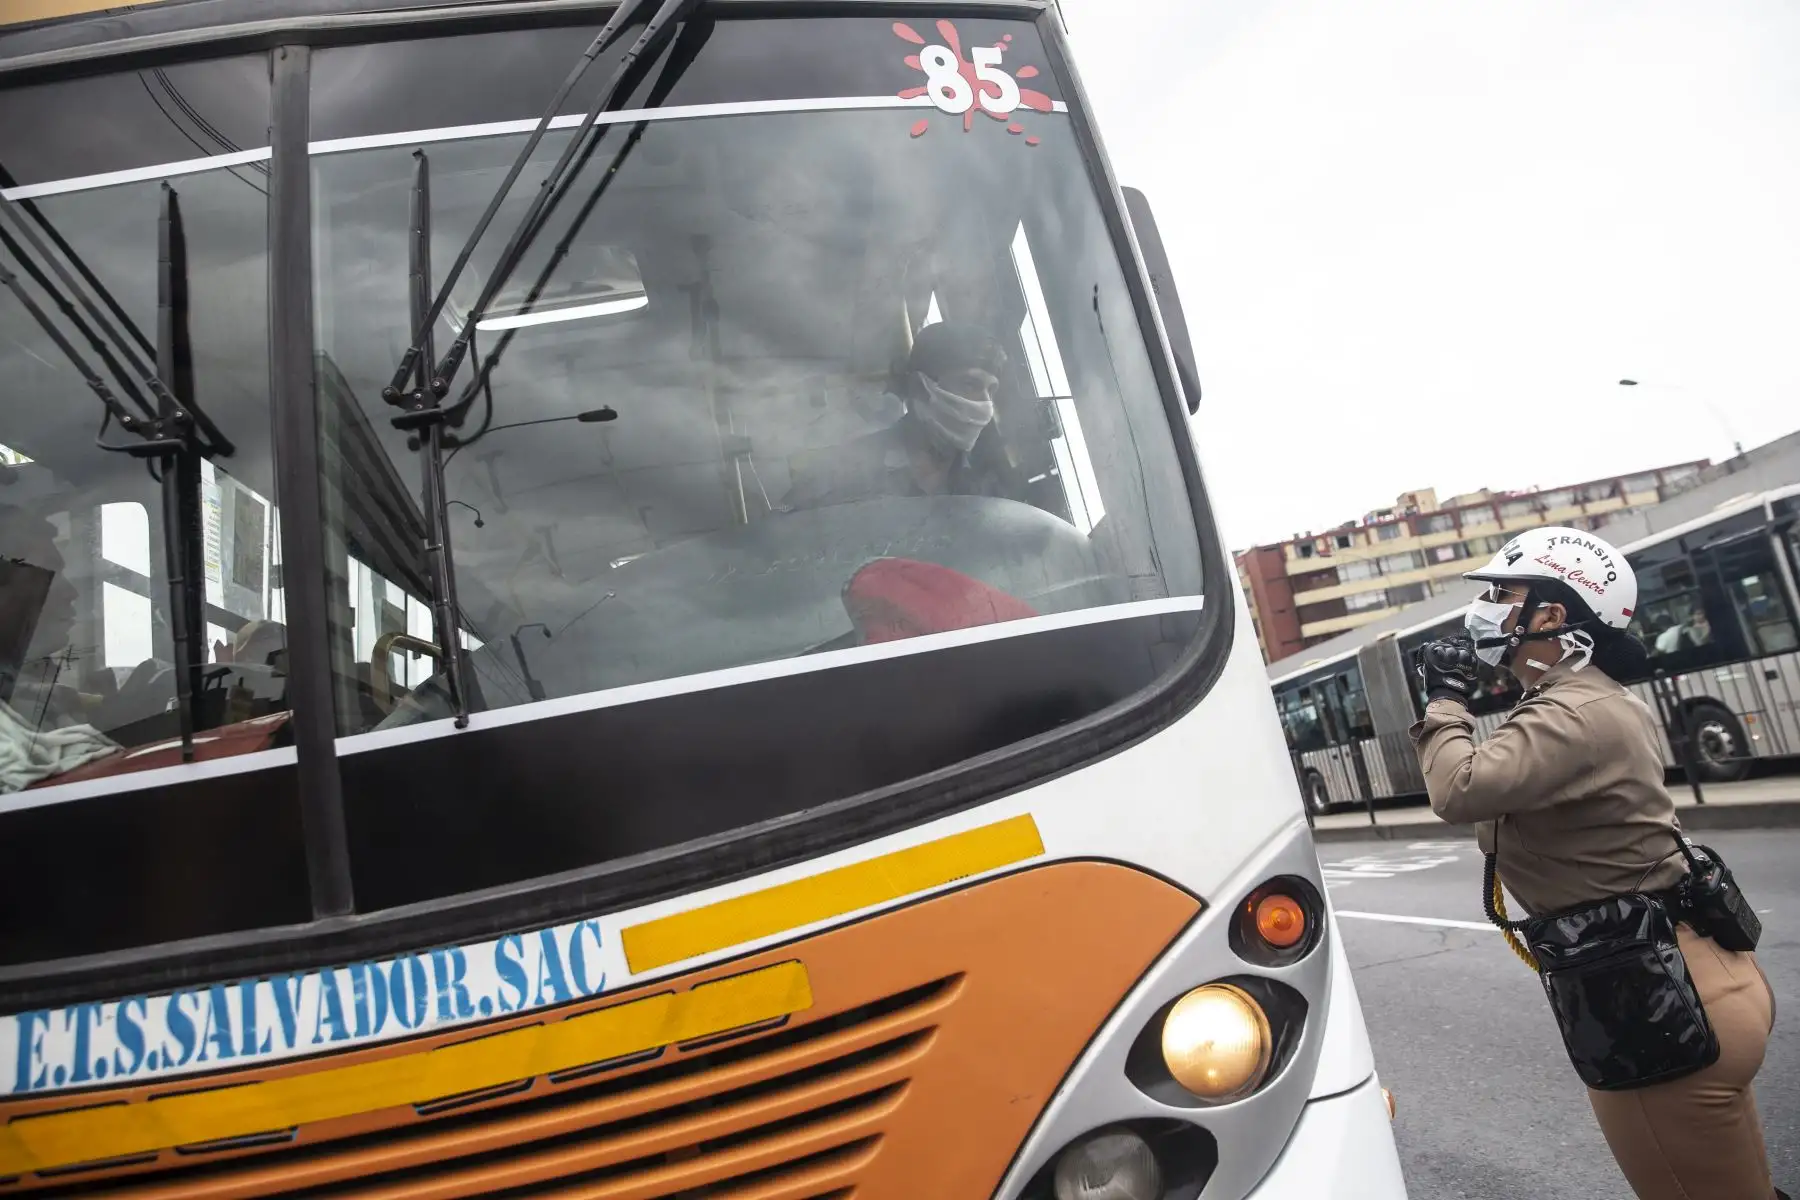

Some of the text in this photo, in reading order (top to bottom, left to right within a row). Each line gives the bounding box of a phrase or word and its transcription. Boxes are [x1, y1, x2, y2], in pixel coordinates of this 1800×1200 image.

[919, 44, 1021, 114] 85
[1534, 554, 1605, 595] Lima Centro
[1547, 536, 1617, 582] TRANSITO
